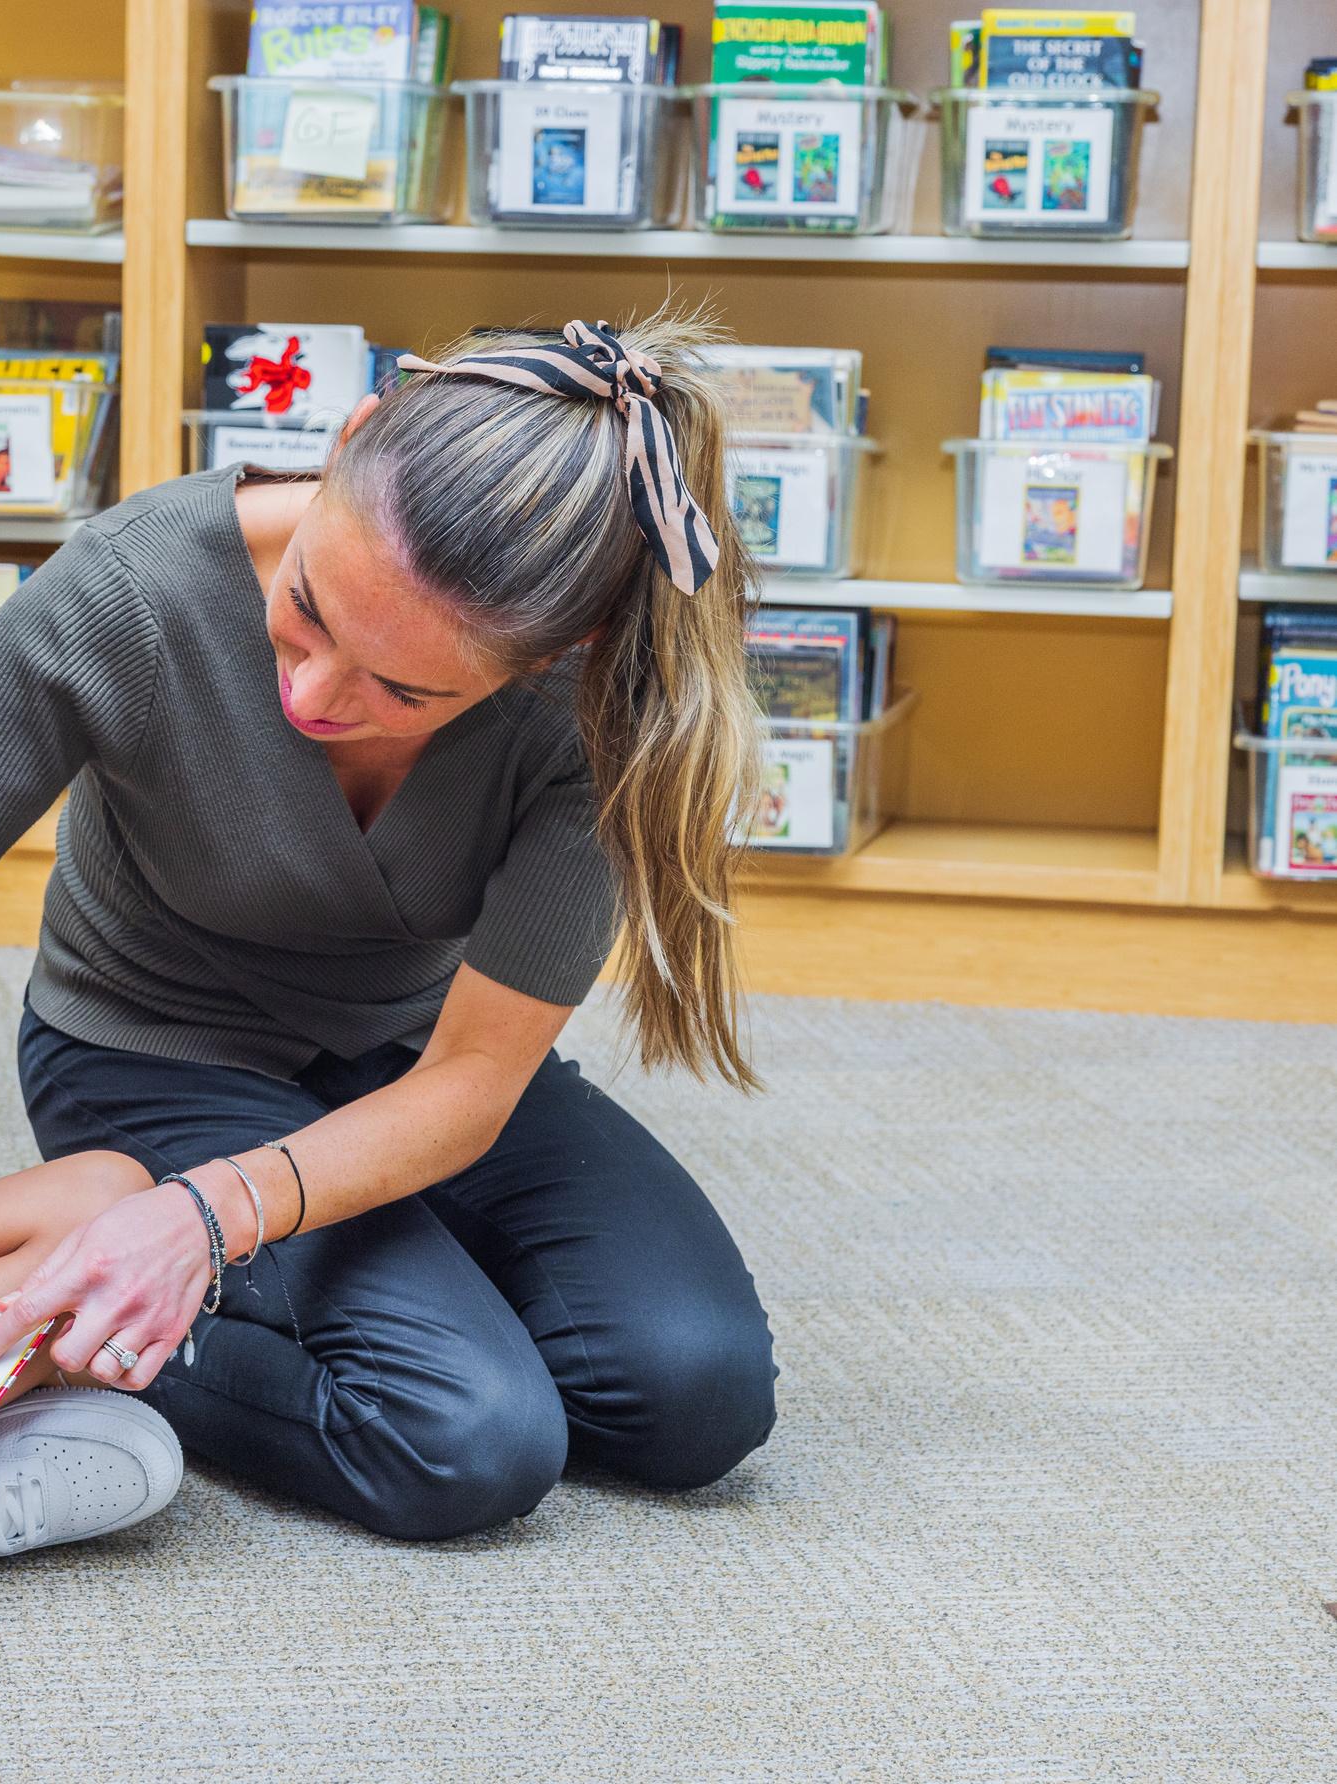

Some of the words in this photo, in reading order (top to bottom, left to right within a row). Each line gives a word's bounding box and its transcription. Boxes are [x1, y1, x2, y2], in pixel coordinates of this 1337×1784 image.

[260, 5, 339, 26] ROSCOE
[262, 24, 372, 74] Rules
[1013, 40, 1043, 56] THE
[1045, 40, 1103, 57] SECRET
[1026, 56, 1051, 72] OF
[1055, 56, 1085, 73] THE
[1007, 72, 1045, 88] OLD
[1046, 73, 1104, 89] CLOCK
[756, 110, 824, 127] Mystery
[1006, 117, 1074, 133] Mystery
[1278, 662, 1337, 708] Pony
